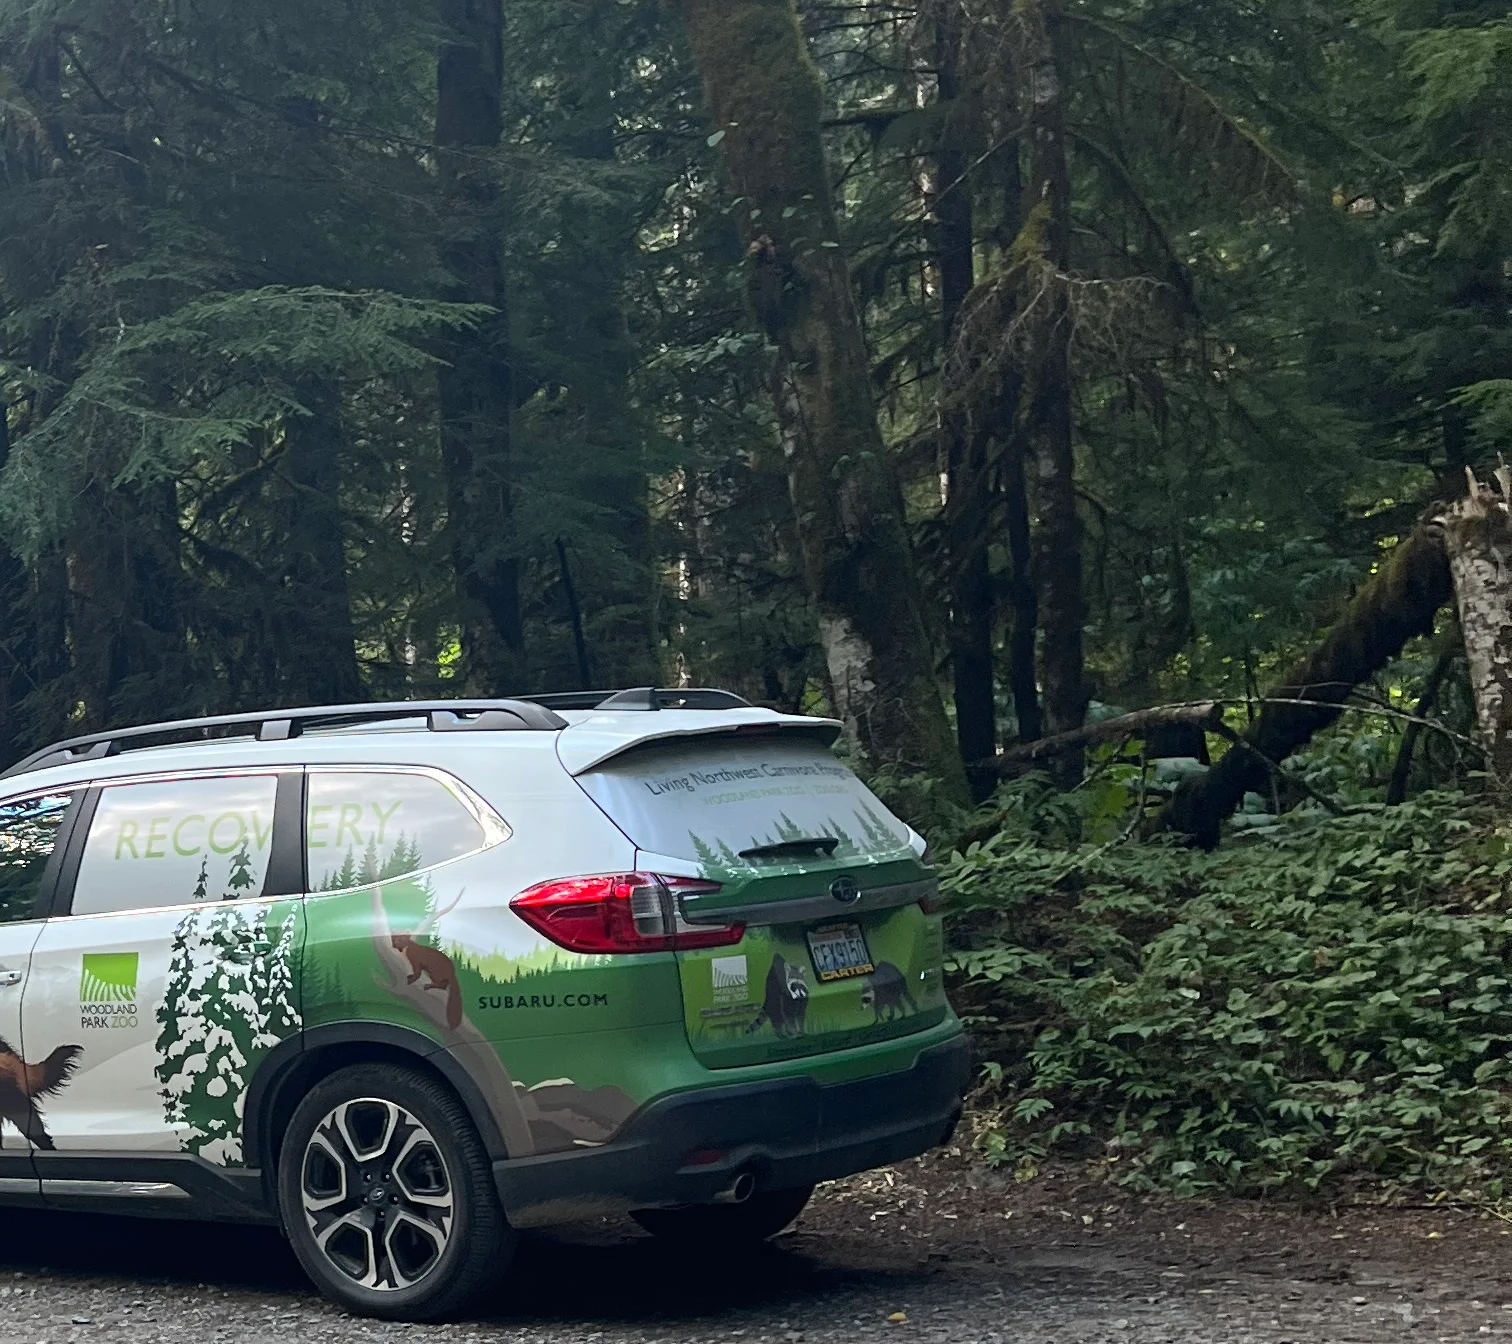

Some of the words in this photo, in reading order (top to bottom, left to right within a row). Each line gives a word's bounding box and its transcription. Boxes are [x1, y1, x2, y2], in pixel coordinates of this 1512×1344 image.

[644, 778, 695, 796] Living
[689, 768, 764, 786] Northwest
[478, 994, 608, 1009] SUBARU.COM
[80, 1003, 138, 1014] WOODLAND
[81, 1016, 109, 1028] PARK
[111, 1016, 138, 1028] ZOO
